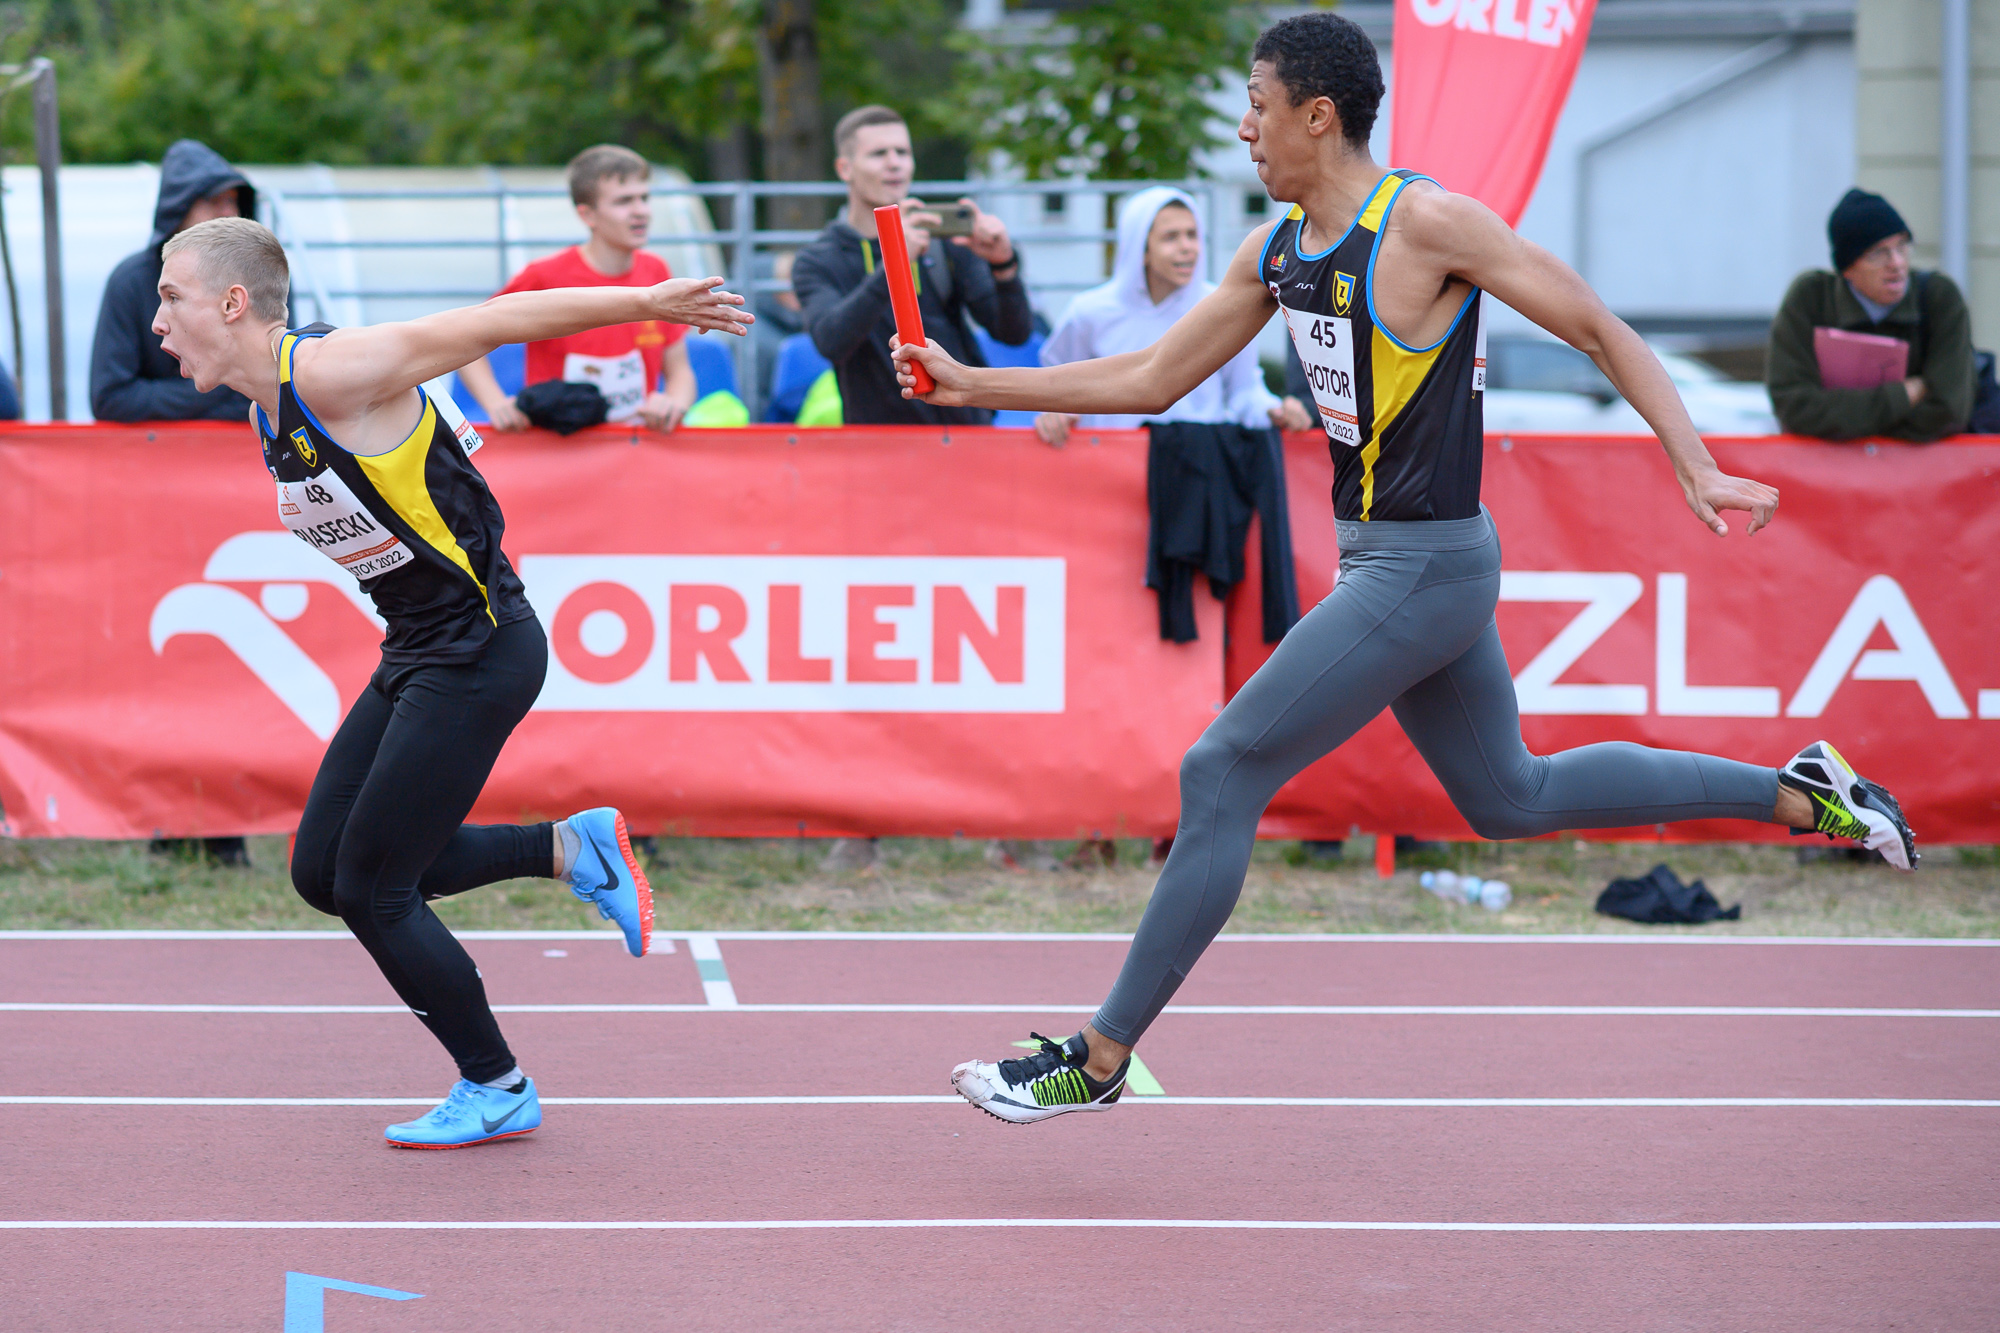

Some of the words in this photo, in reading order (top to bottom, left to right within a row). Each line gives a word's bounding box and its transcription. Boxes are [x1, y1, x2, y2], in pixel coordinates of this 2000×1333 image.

[1310, 319, 1336, 348] 45
[1303, 360, 1352, 399] HOTOR
[1332, 422, 1355, 441] 2022
[304, 484, 334, 506] 48
[292, 511, 377, 548] PIASECKI
[376, 550, 405, 569] 2022
[551, 580, 1026, 685] ORLEN
